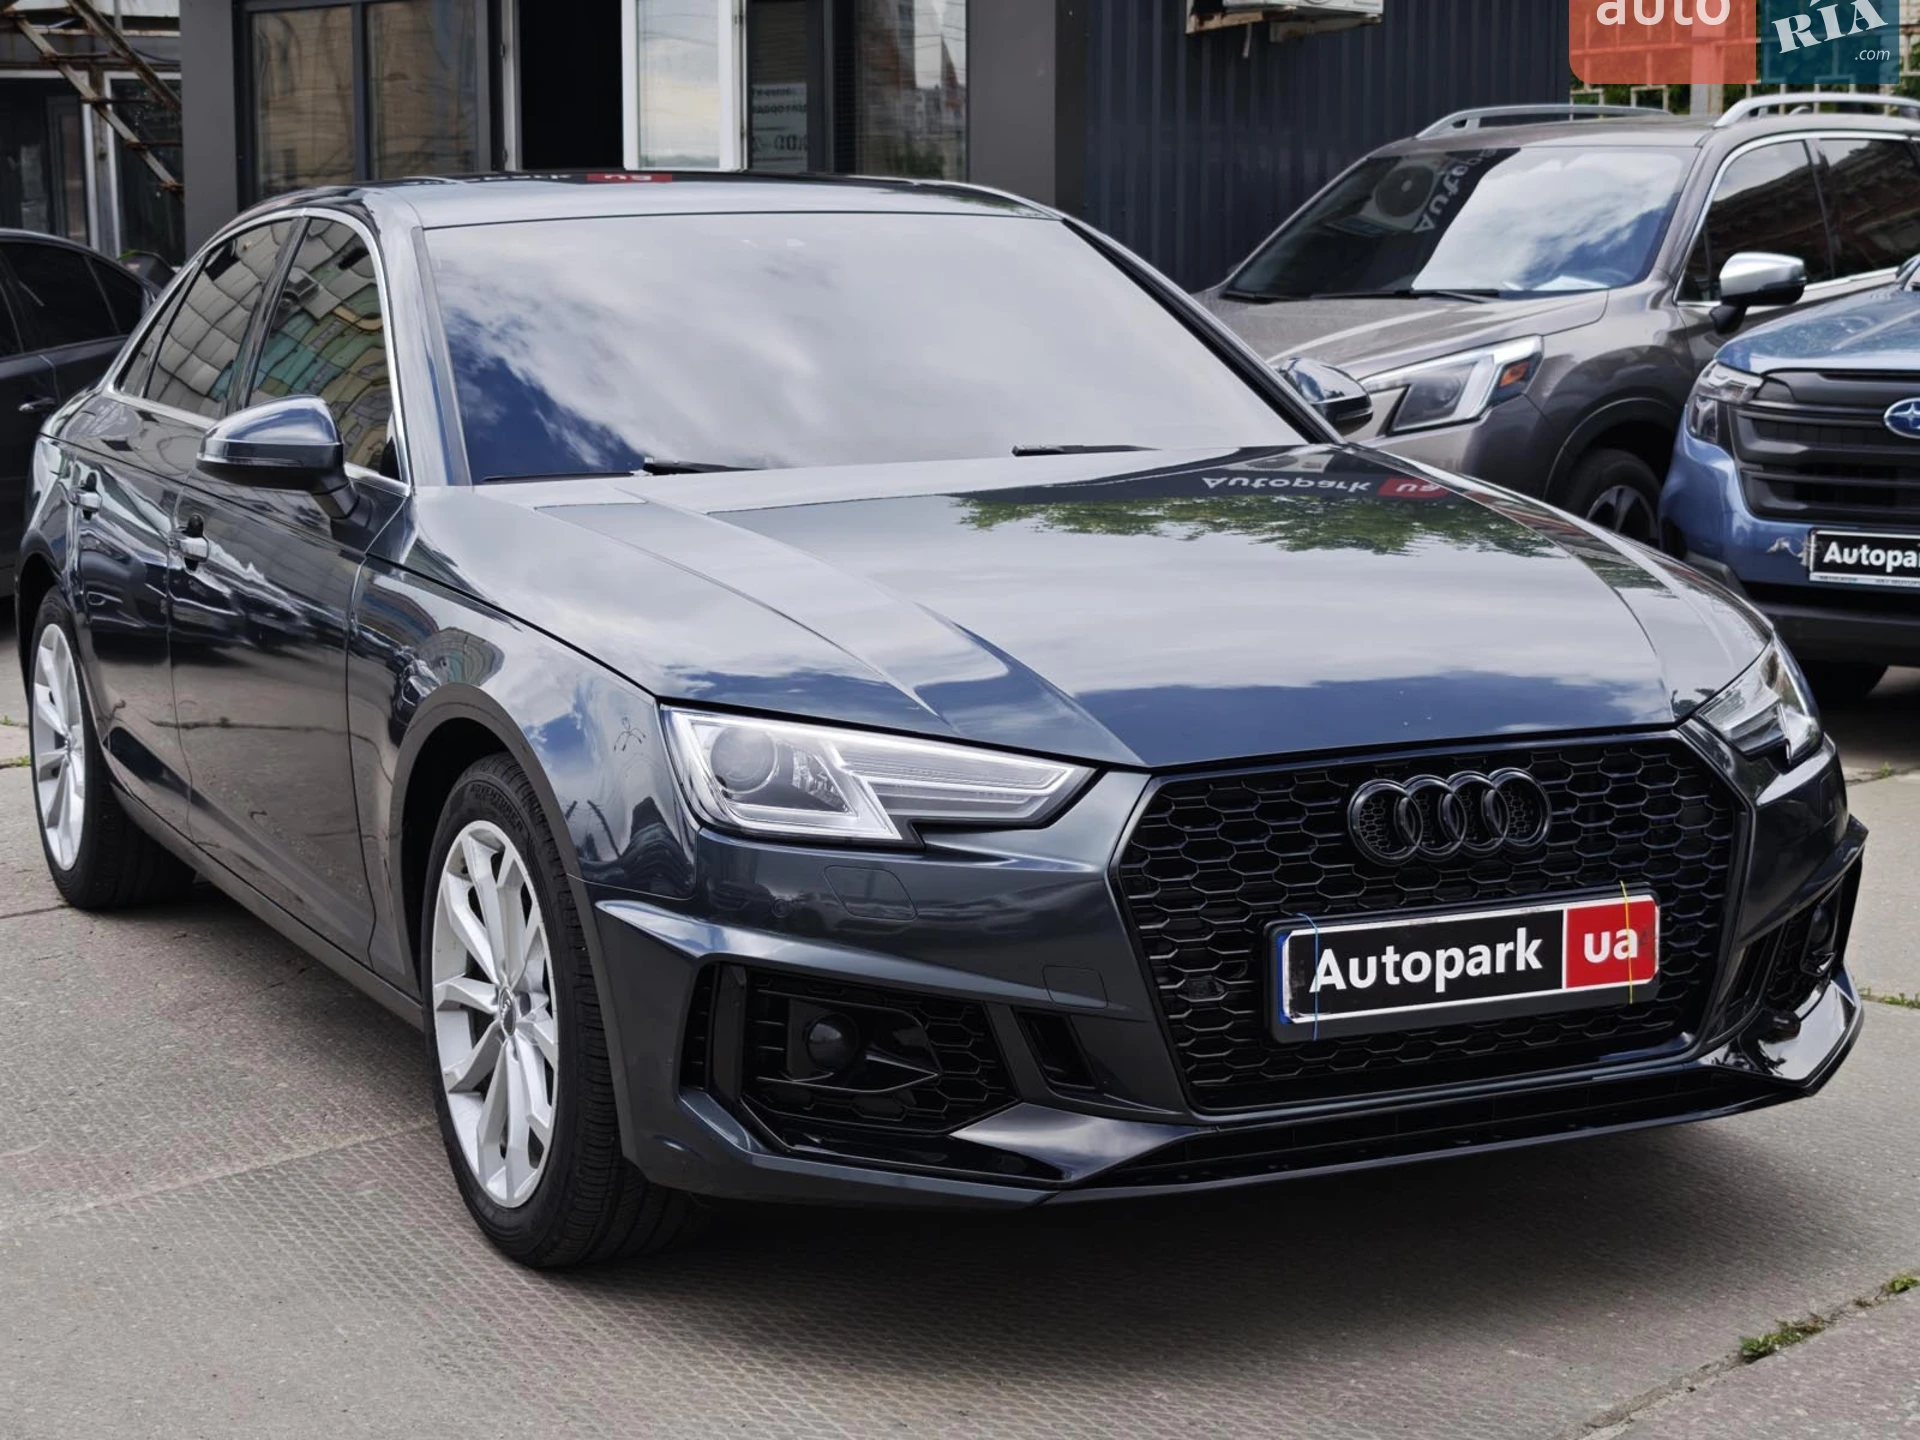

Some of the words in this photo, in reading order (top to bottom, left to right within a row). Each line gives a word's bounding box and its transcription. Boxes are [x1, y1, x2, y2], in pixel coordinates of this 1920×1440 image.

[1823, 541, 1920, 573] Autopa
[1309, 927, 1543, 993] Autopark
[1583, 927, 1639, 963] ua
